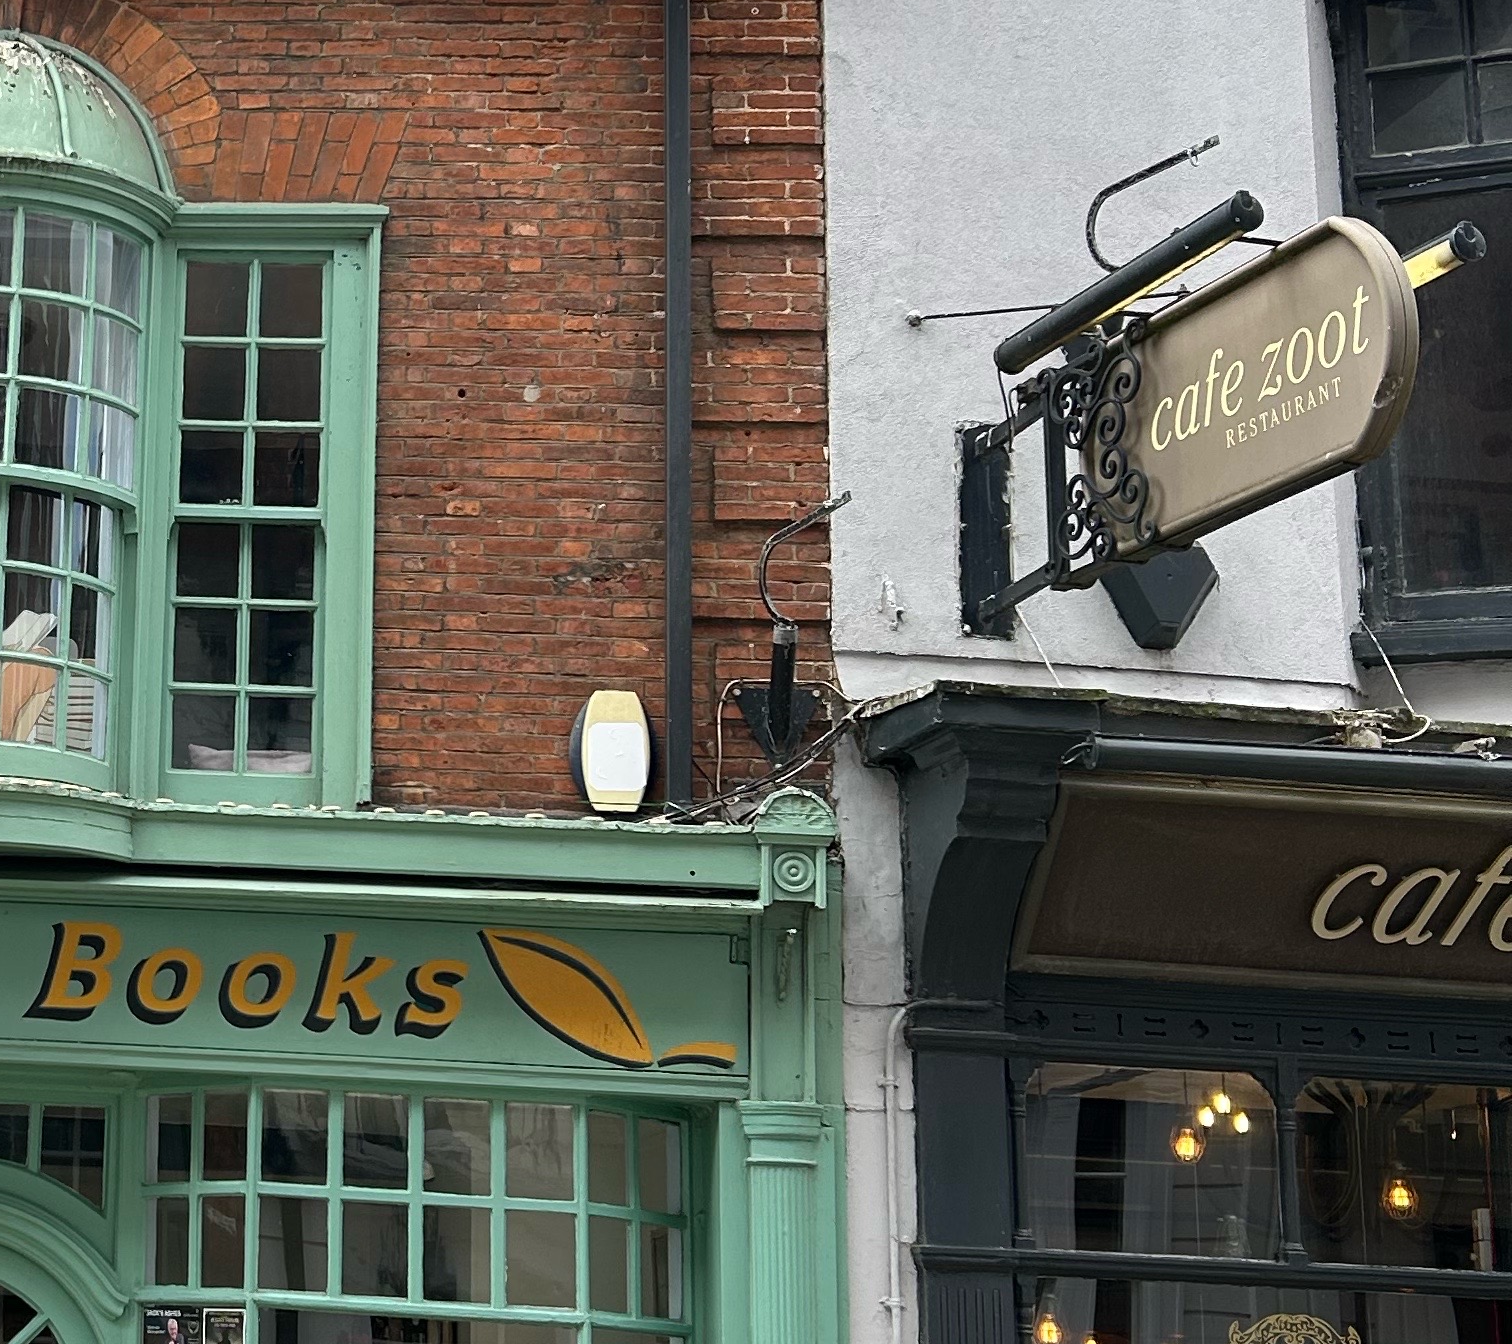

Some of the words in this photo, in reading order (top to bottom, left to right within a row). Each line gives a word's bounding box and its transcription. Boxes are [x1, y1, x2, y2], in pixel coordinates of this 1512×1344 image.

[1151, 347, 1245, 452] cafe
[1257, 285, 1370, 403] zoot
[1225, 377, 1342, 449] RESTAURANT
[23, 920, 469, 1041] Books
